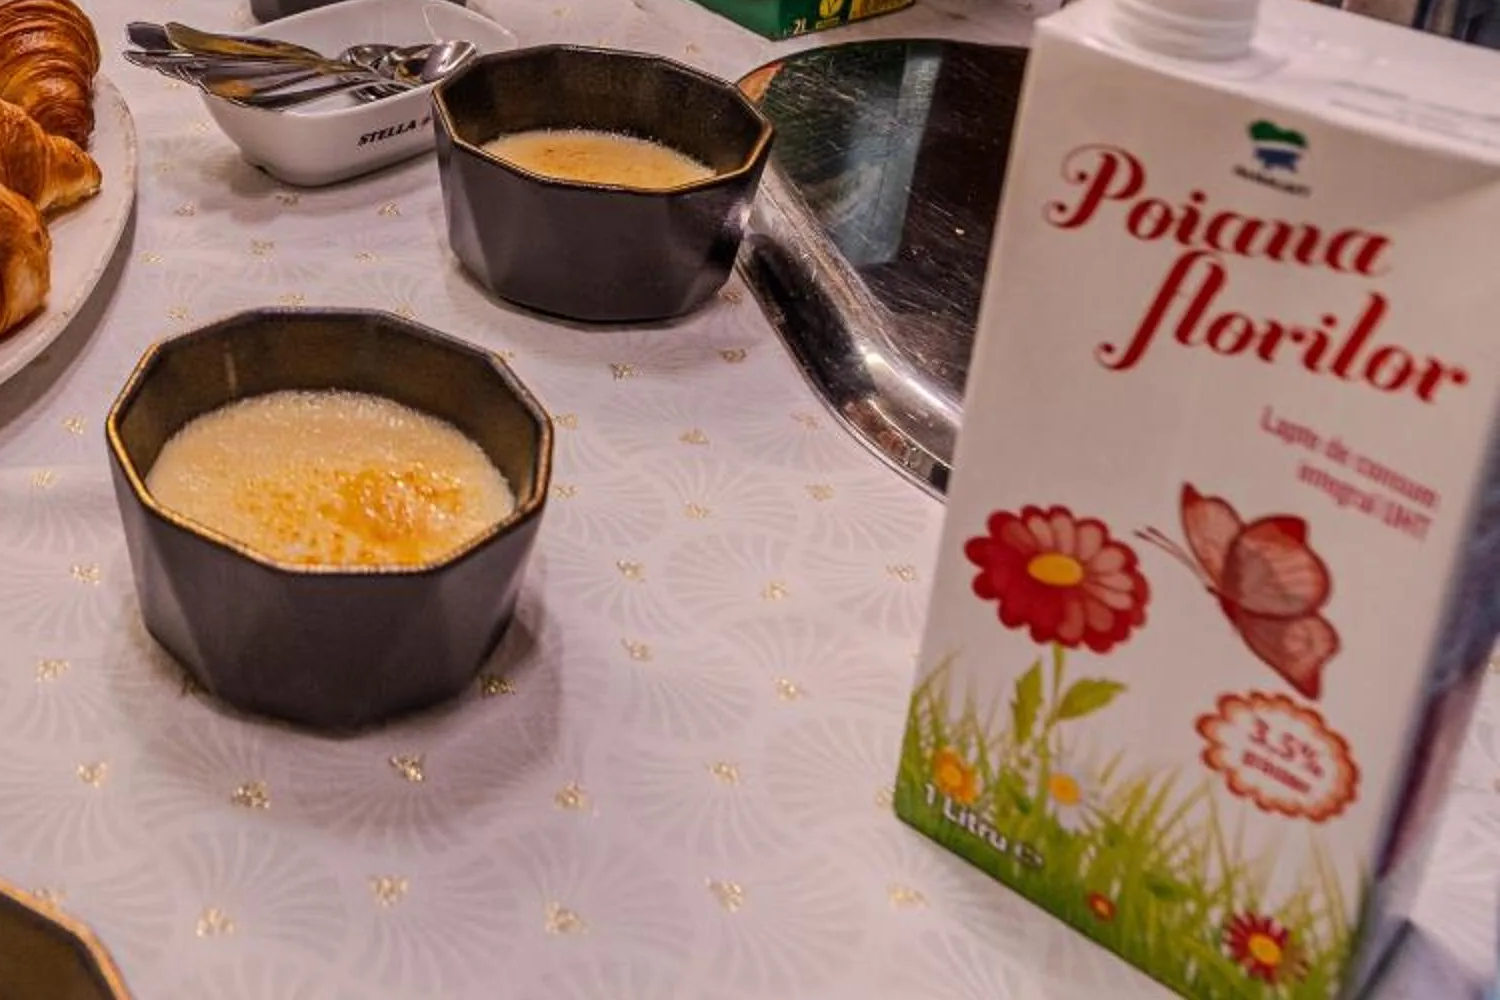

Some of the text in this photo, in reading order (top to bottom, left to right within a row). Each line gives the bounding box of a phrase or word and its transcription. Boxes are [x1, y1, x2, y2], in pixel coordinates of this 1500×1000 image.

[358, 120, 416, 147] STELLA
[1043, 144, 1393, 278] Poiana
[1094, 249, 1469, 403] florilor
[924, 783, 1008, 853] 1 Litru
